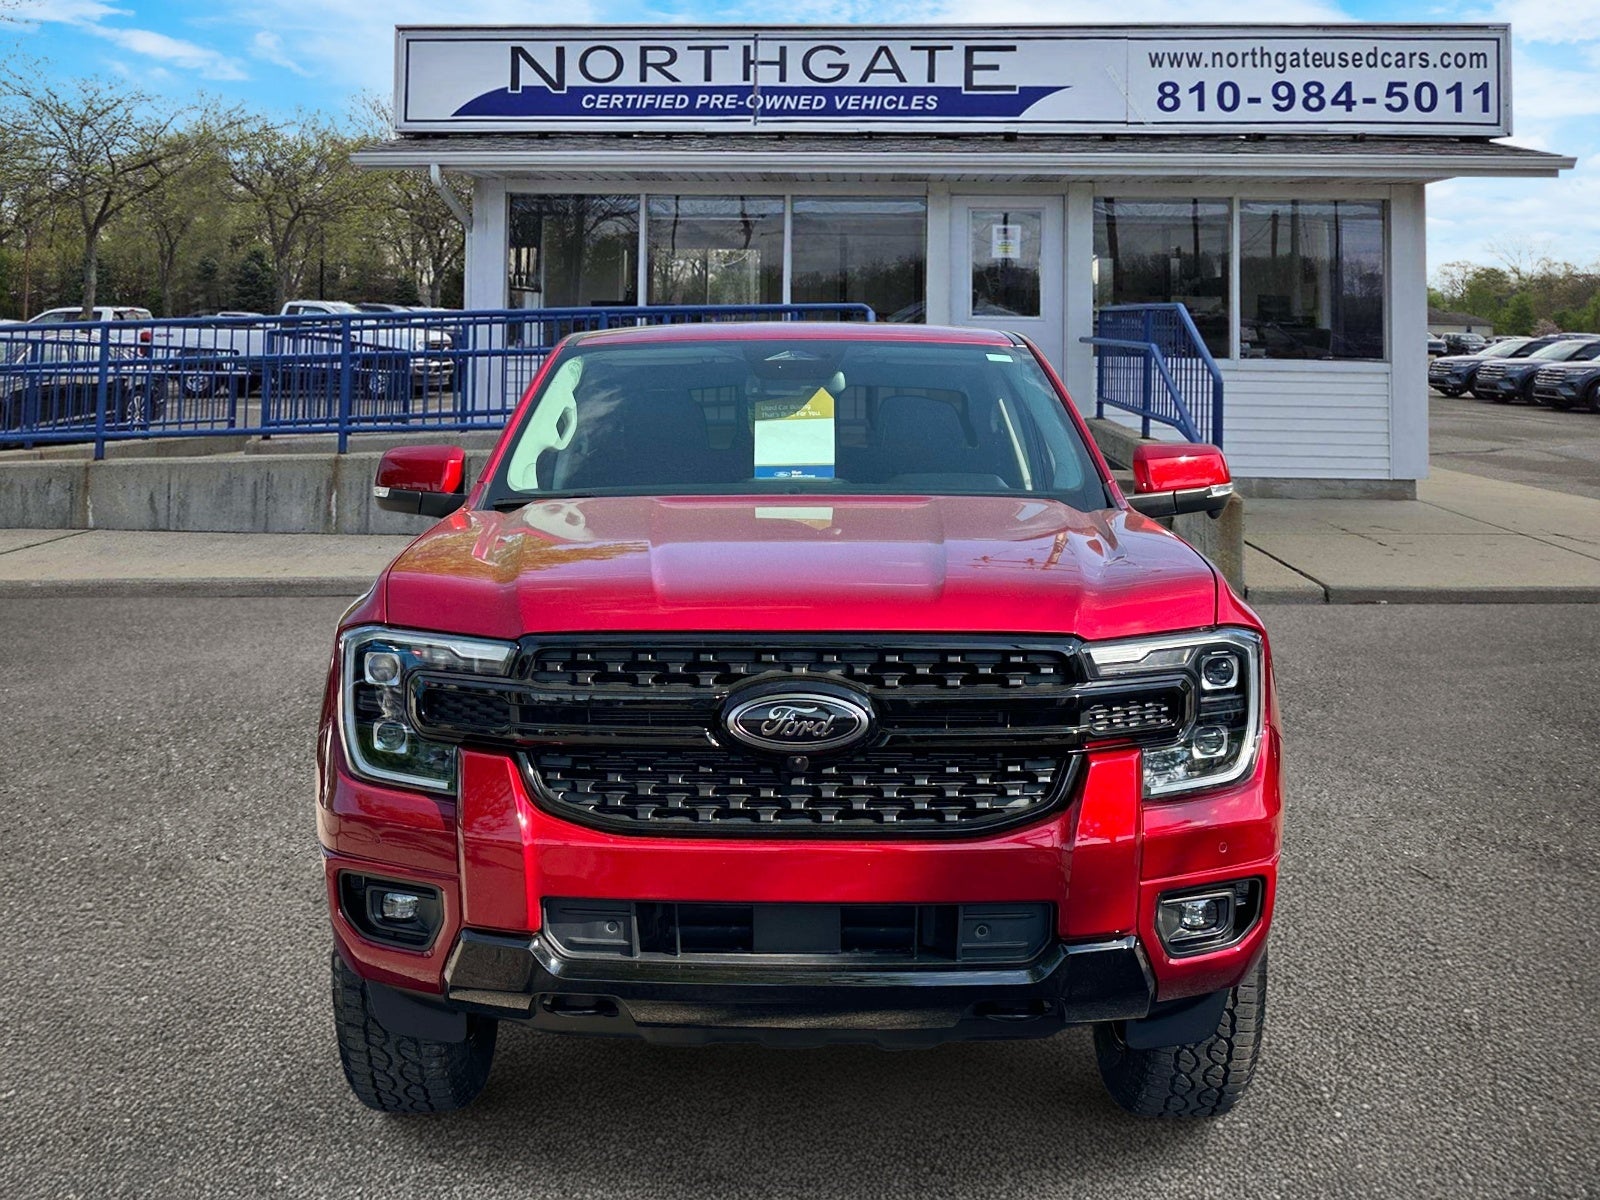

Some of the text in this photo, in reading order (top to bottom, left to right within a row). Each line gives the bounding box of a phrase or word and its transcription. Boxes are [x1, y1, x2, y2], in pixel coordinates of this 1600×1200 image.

[511, 45, 1017, 91] NORTHGATE
[1149, 47, 1487, 73] www.northgateusedcars.com
[581, 94, 938, 110] CERTIFIED PRE-OWNED VEHICLES
[1157, 81, 1491, 113] 810-984-5011
[760, 705, 835, 737] Ford
